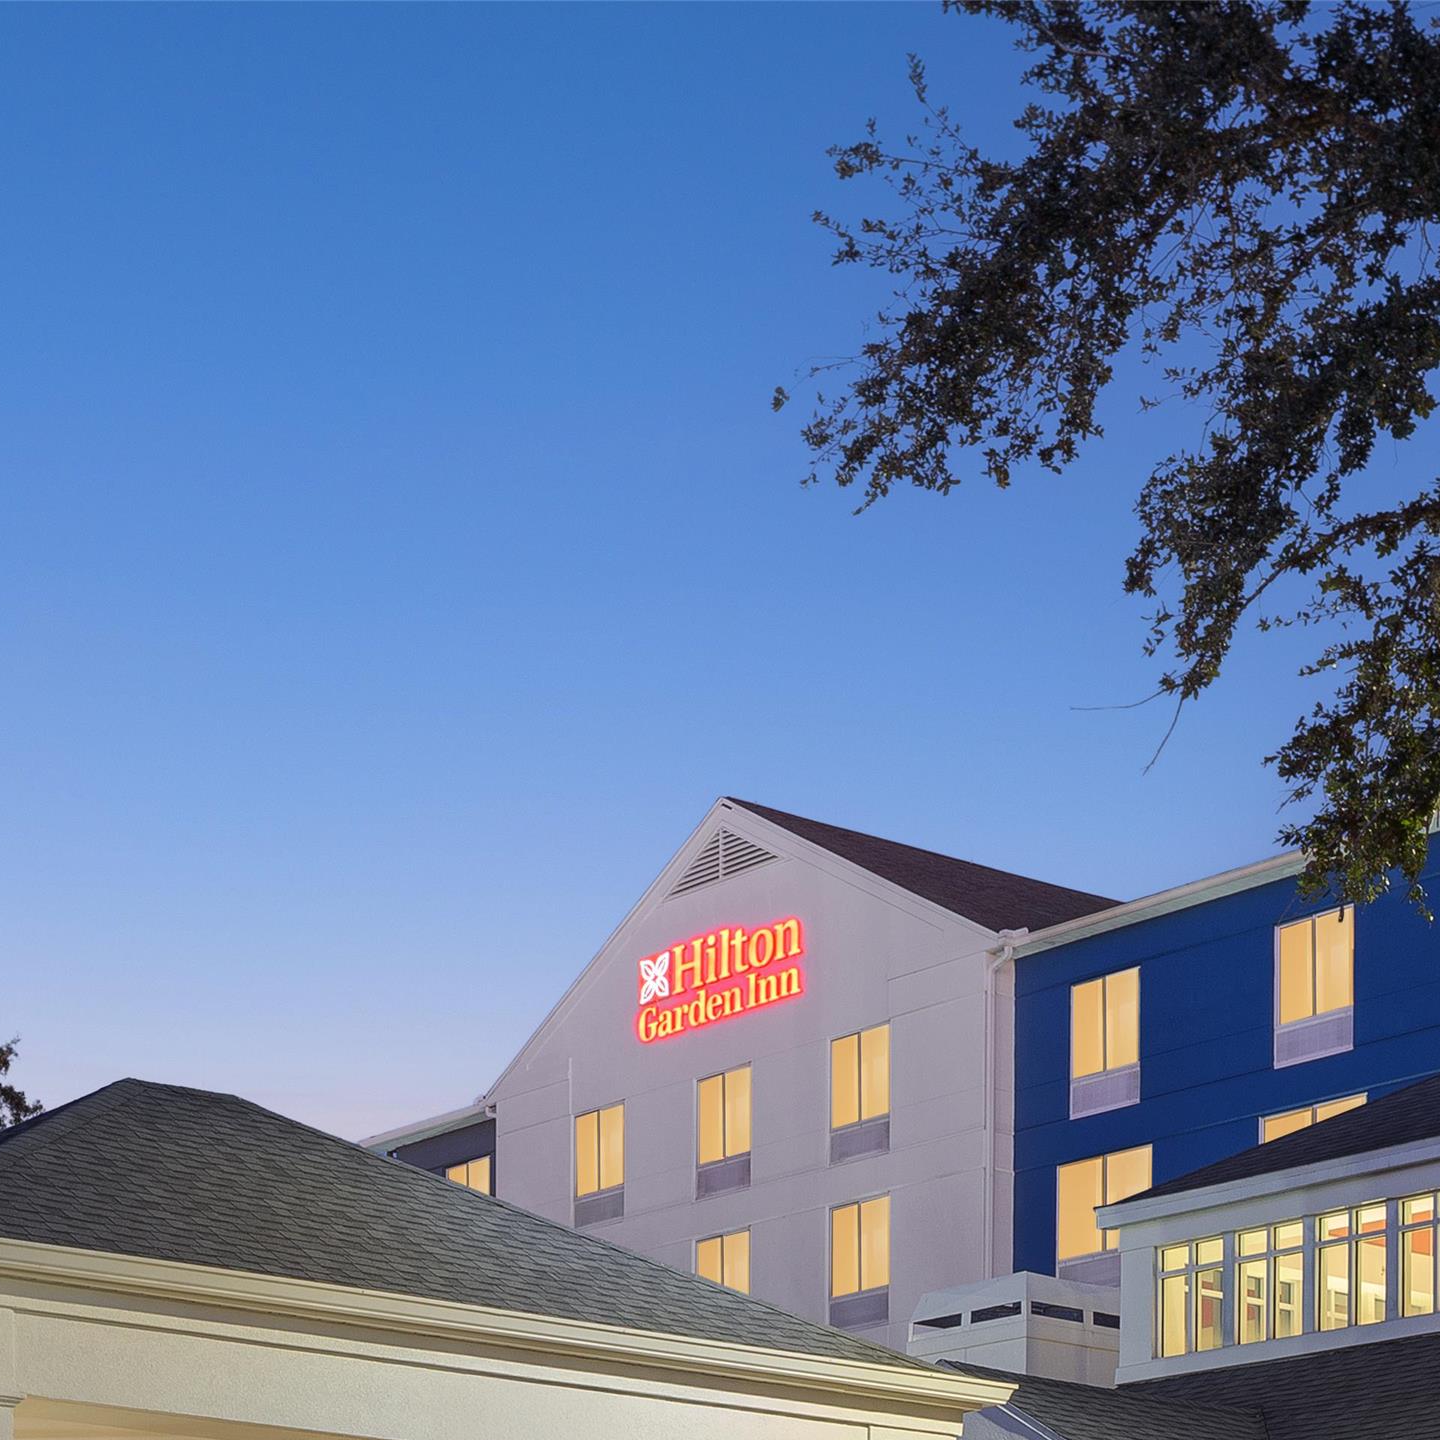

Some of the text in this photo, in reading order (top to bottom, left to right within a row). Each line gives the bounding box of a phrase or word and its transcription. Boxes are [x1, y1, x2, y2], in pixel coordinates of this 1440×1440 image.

[671, 918, 802, 995] Hilton
[638, 967, 802, 1042] Garden Inn
